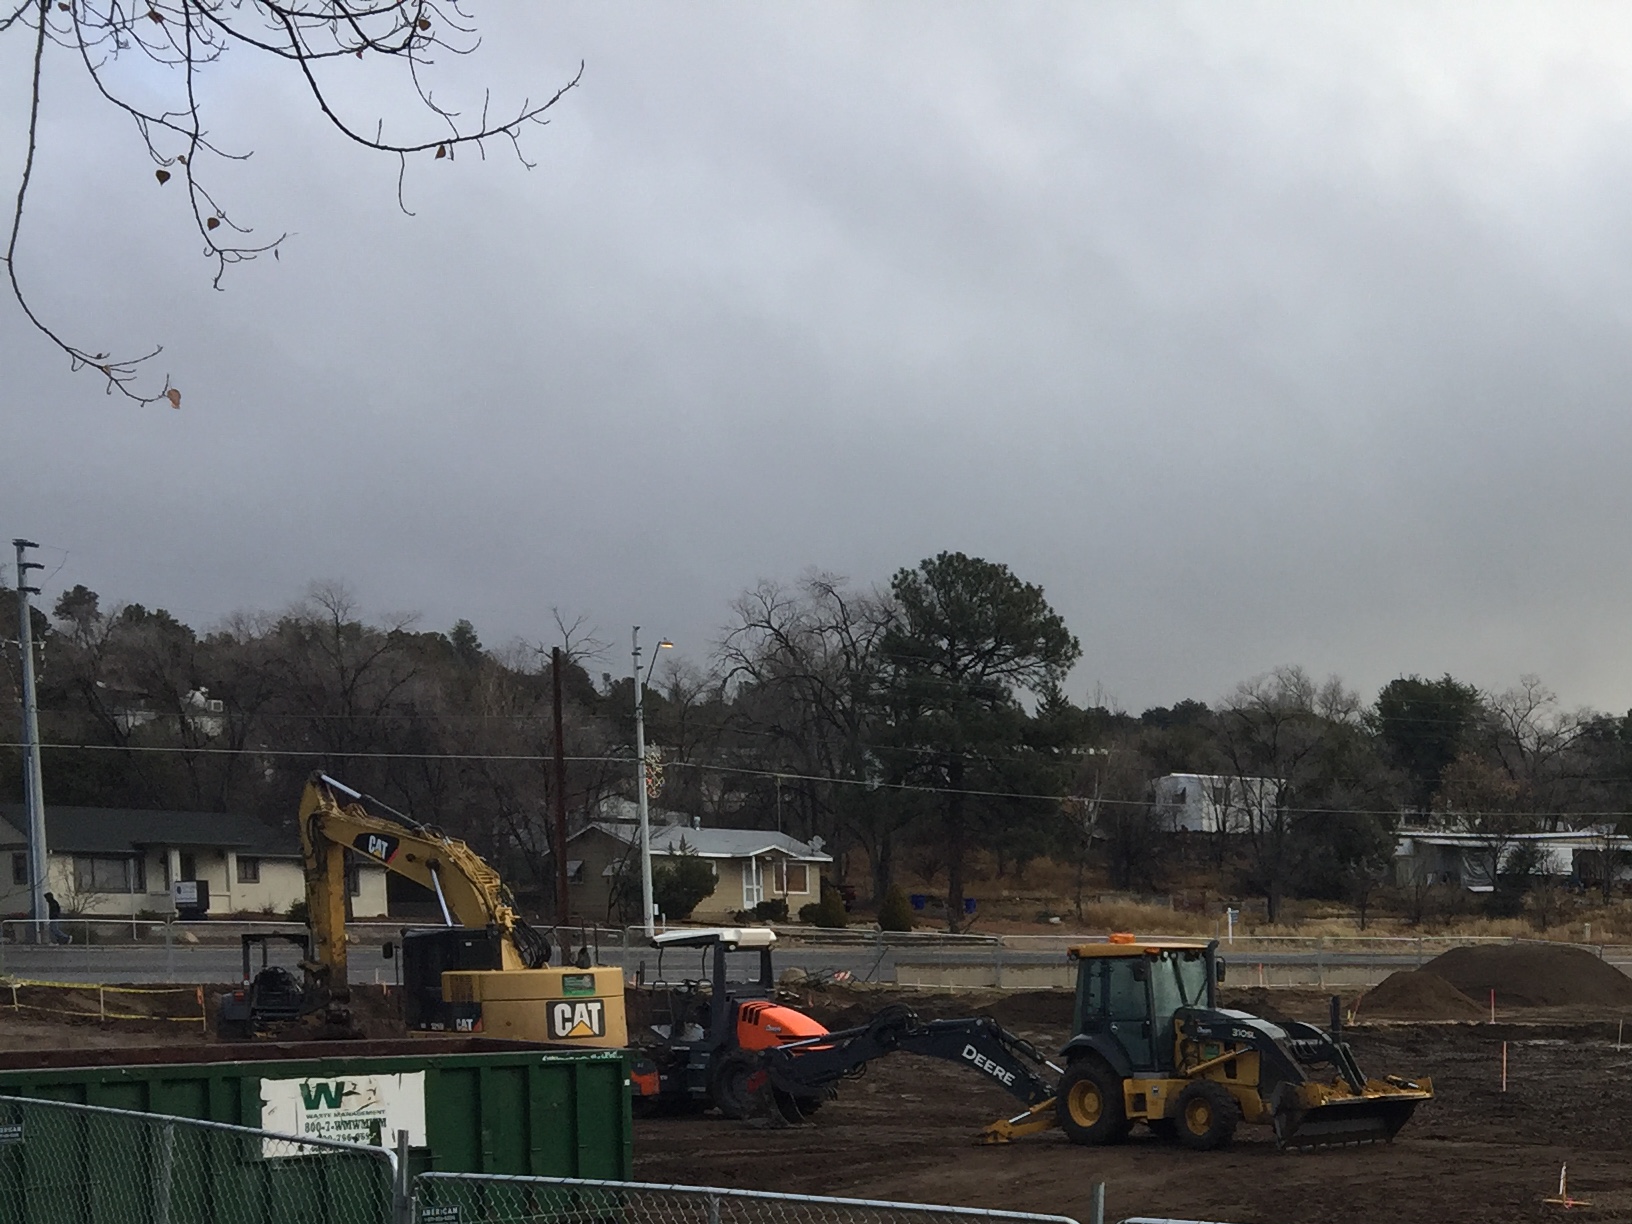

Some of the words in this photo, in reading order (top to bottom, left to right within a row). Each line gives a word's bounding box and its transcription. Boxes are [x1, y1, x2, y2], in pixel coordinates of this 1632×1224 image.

[368, 835, 388, 859] CAT
[456, 1018, 473, 1031] CAT
[554, 1003, 601, 1037] CAT
[962, 1043, 1016, 1086] DEERE
[422, 1207, 458, 1216] AMERICAN
